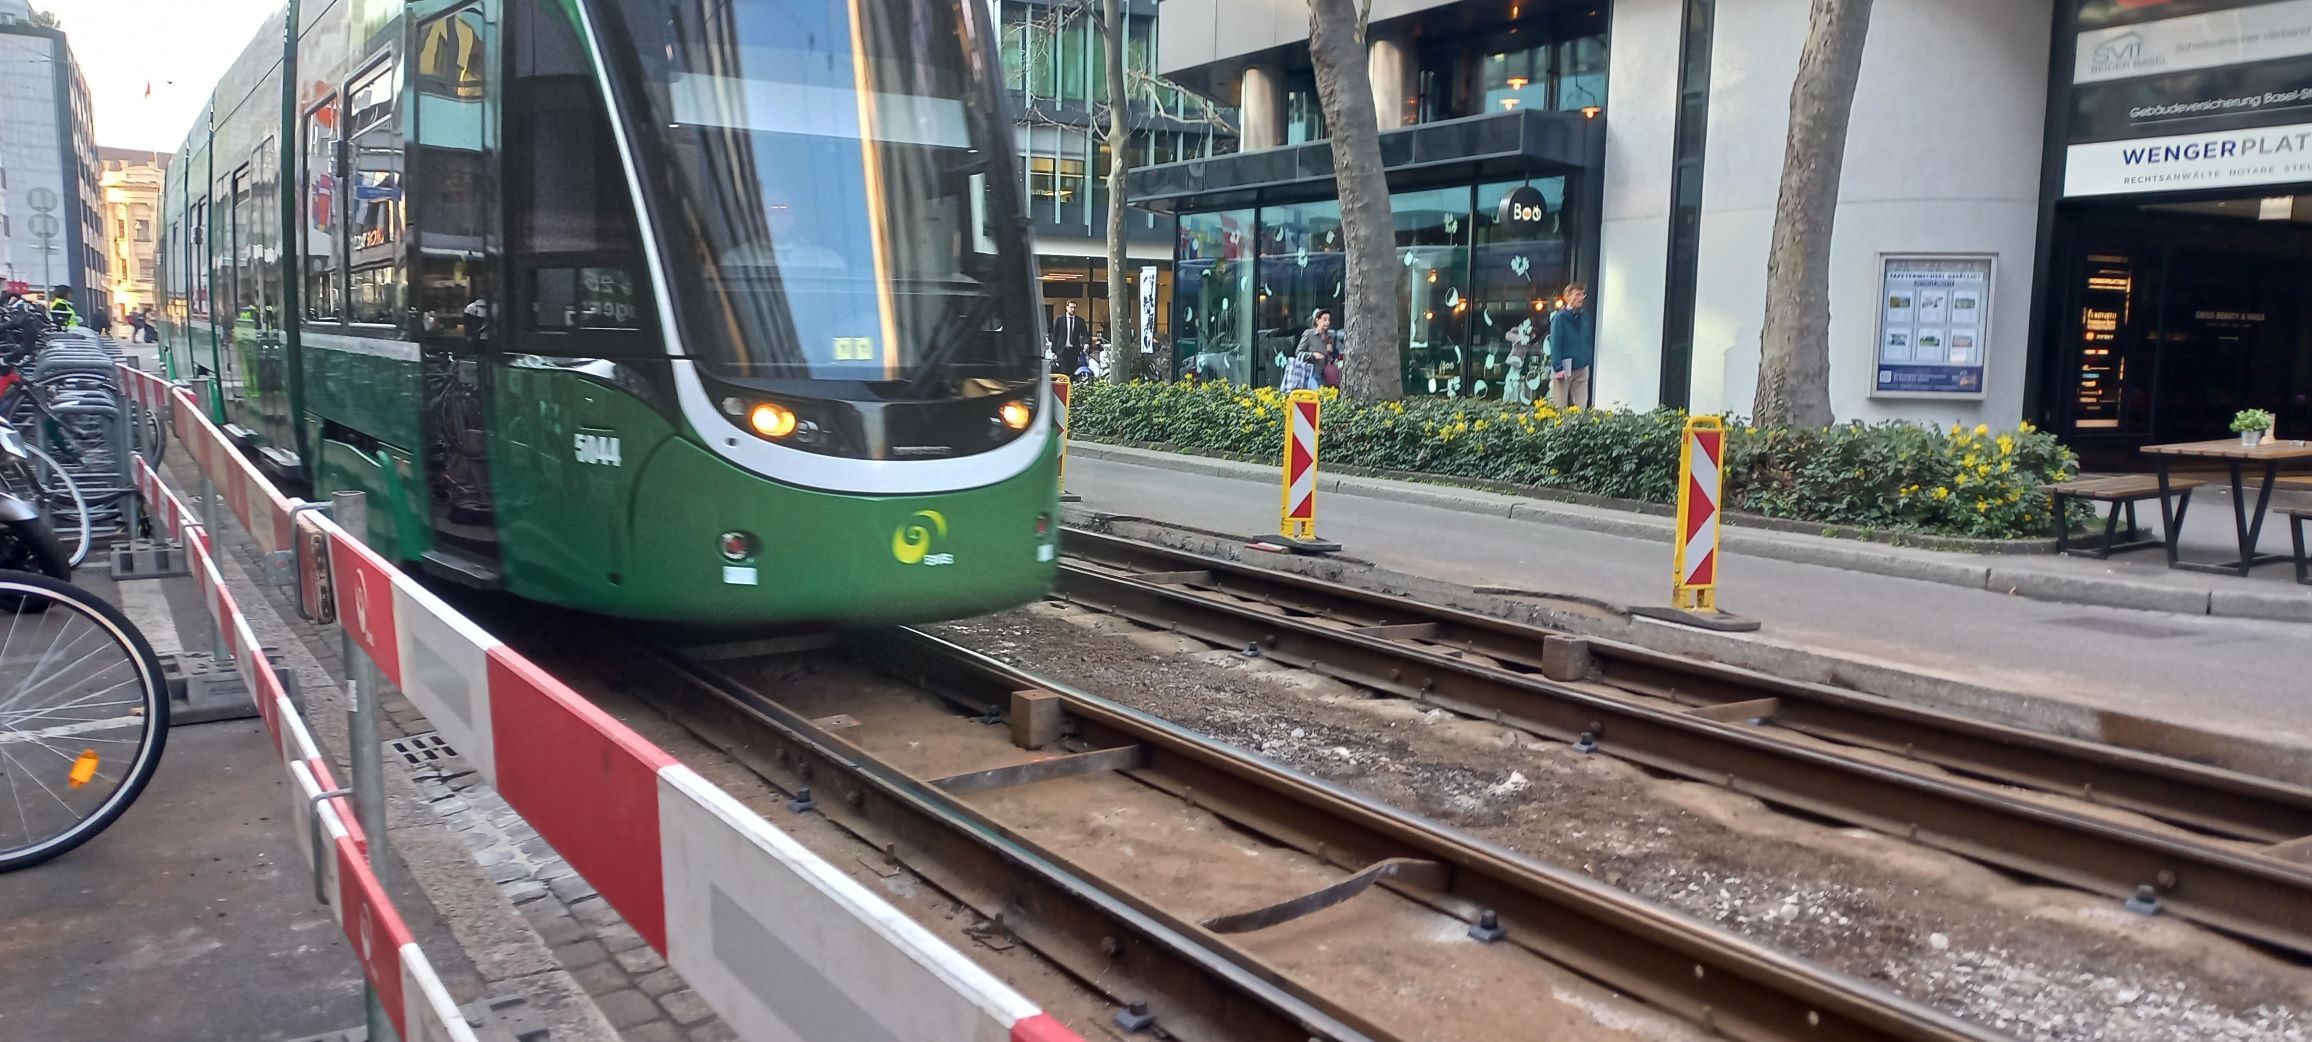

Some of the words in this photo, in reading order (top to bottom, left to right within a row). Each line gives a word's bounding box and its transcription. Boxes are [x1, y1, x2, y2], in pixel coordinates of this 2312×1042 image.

[2092, 37, 2145, 65] SVIT
[2133, 56, 2167, 68] BASEL
[2129, 94, 2262, 119] Gebäudeversicherung
[2124, 169, 2221, 186] RECHTSANWÄLTE
[2229, 166, 2275, 178] NOTARE
[574, 433, 622, 467] 5044
